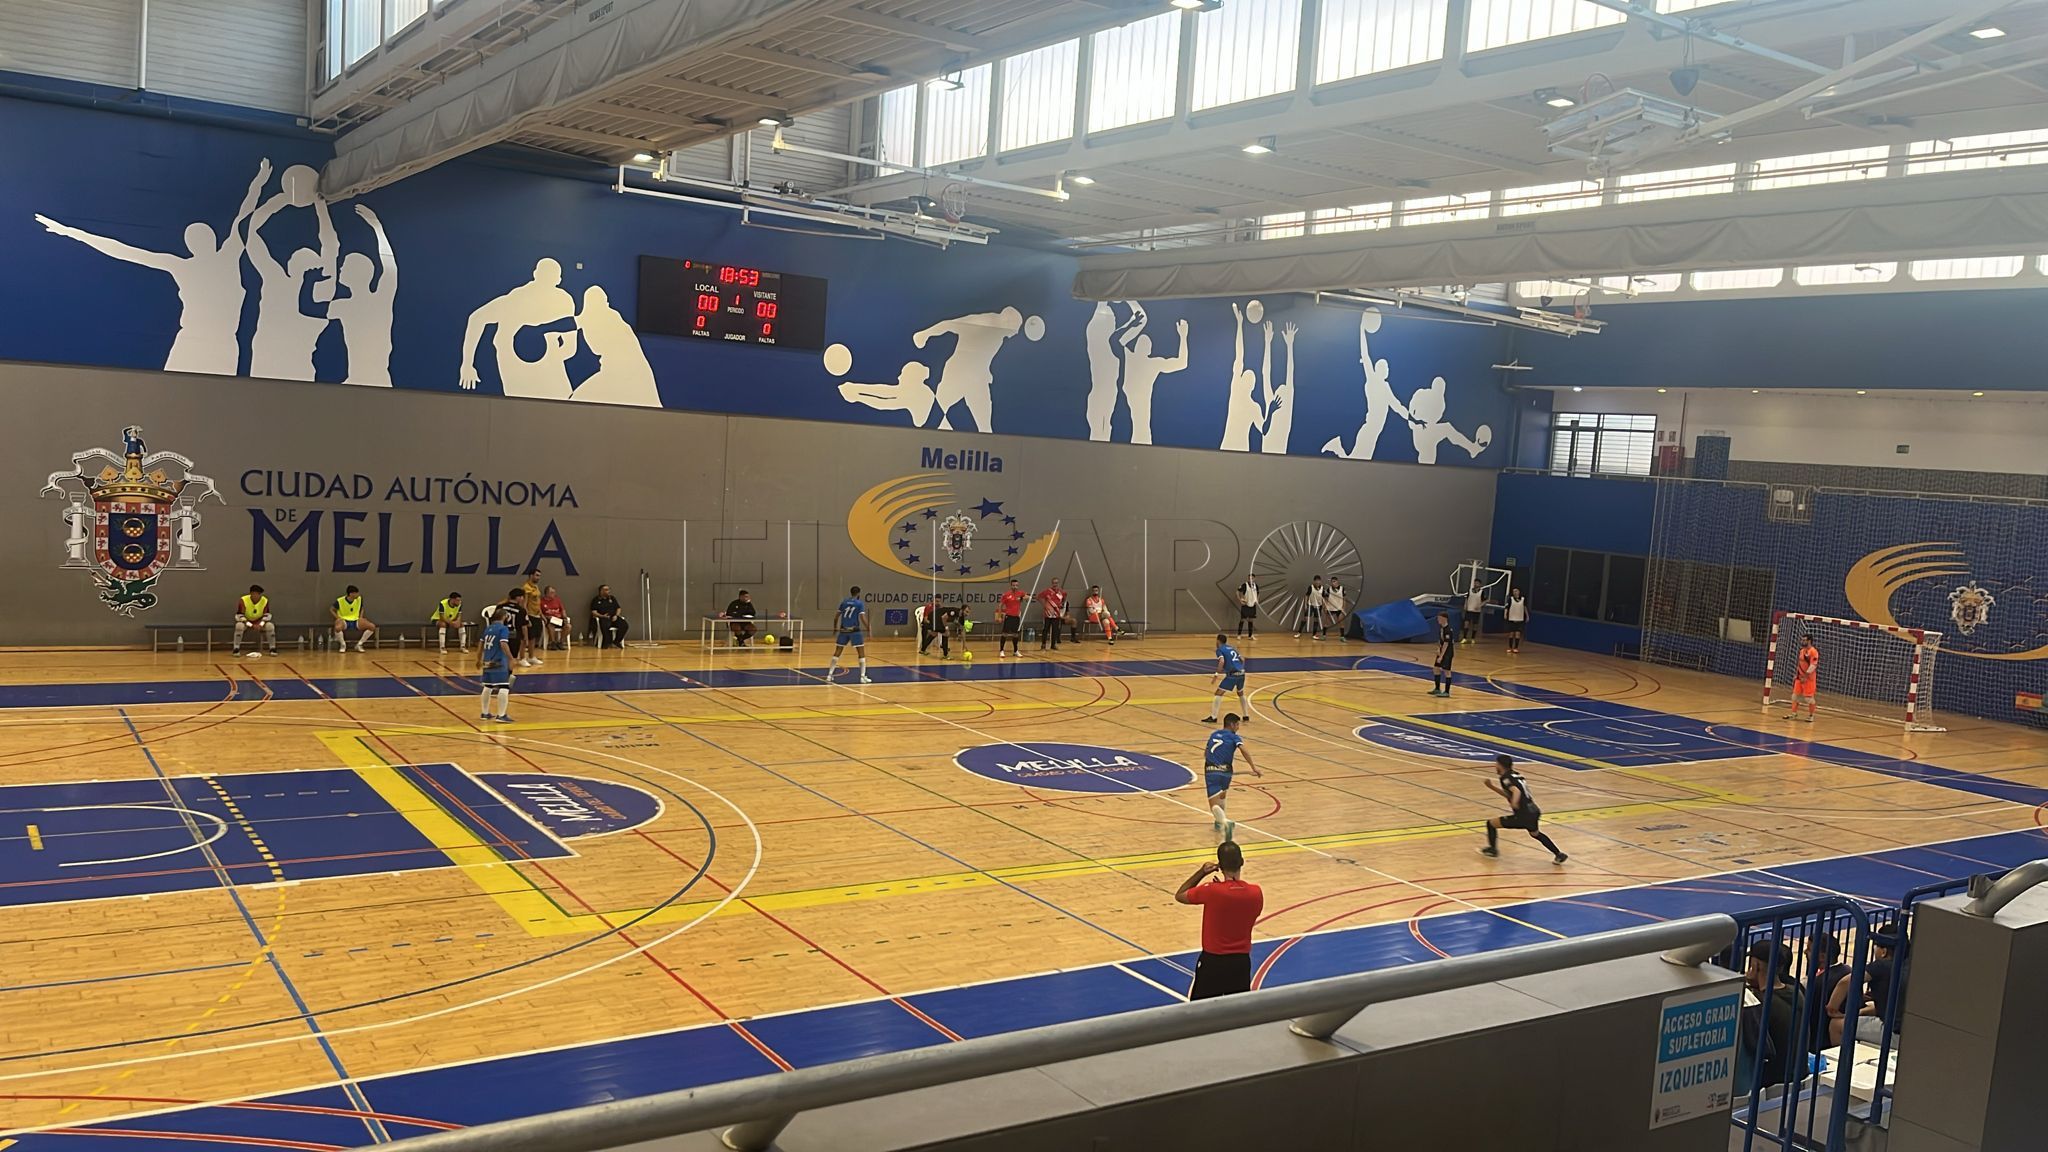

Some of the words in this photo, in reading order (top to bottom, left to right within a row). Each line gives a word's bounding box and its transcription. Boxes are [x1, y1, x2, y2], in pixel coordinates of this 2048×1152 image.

[695, 284, 719, 293] LOCAL
[754, 291, 777, 300] VISITANTE
[697, 294, 720, 312] 00
[734, 294, 740, 305] 1
[756, 301, 777, 319] 00
[696, 315, 706, 327] 0
[762, 323, 772, 335] 0
[724, 333, 746, 341] JUGADOR
[921, 447, 1003, 473] Melilla
[240, 469, 373, 499] CIUDAD
[384, 472, 579, 508] AUTÓNOMA
[275, 508, 297, 522] DE
[246, 508, 579, 576] MELILLA
[864, 593, 908, 603] CIUDAD
[912, 593, 963, 604] EURPEA
[966, 594, 987, 604] DEL
[843, 606, 856, 619] 11
[483, 634, 495, 650] 14
[1210, 738, 1224, 754] 7
[996, 755, 1139, 772] MELILLA
[1663, 1012, 1701, 1035] ACCESO
[1705, 1004, 1736, 1025] GRADA
[1668, 1027, 1727, 1055] SUPLETORIA
[1659, 1057, 1728, 1094] IZQUIERDA
